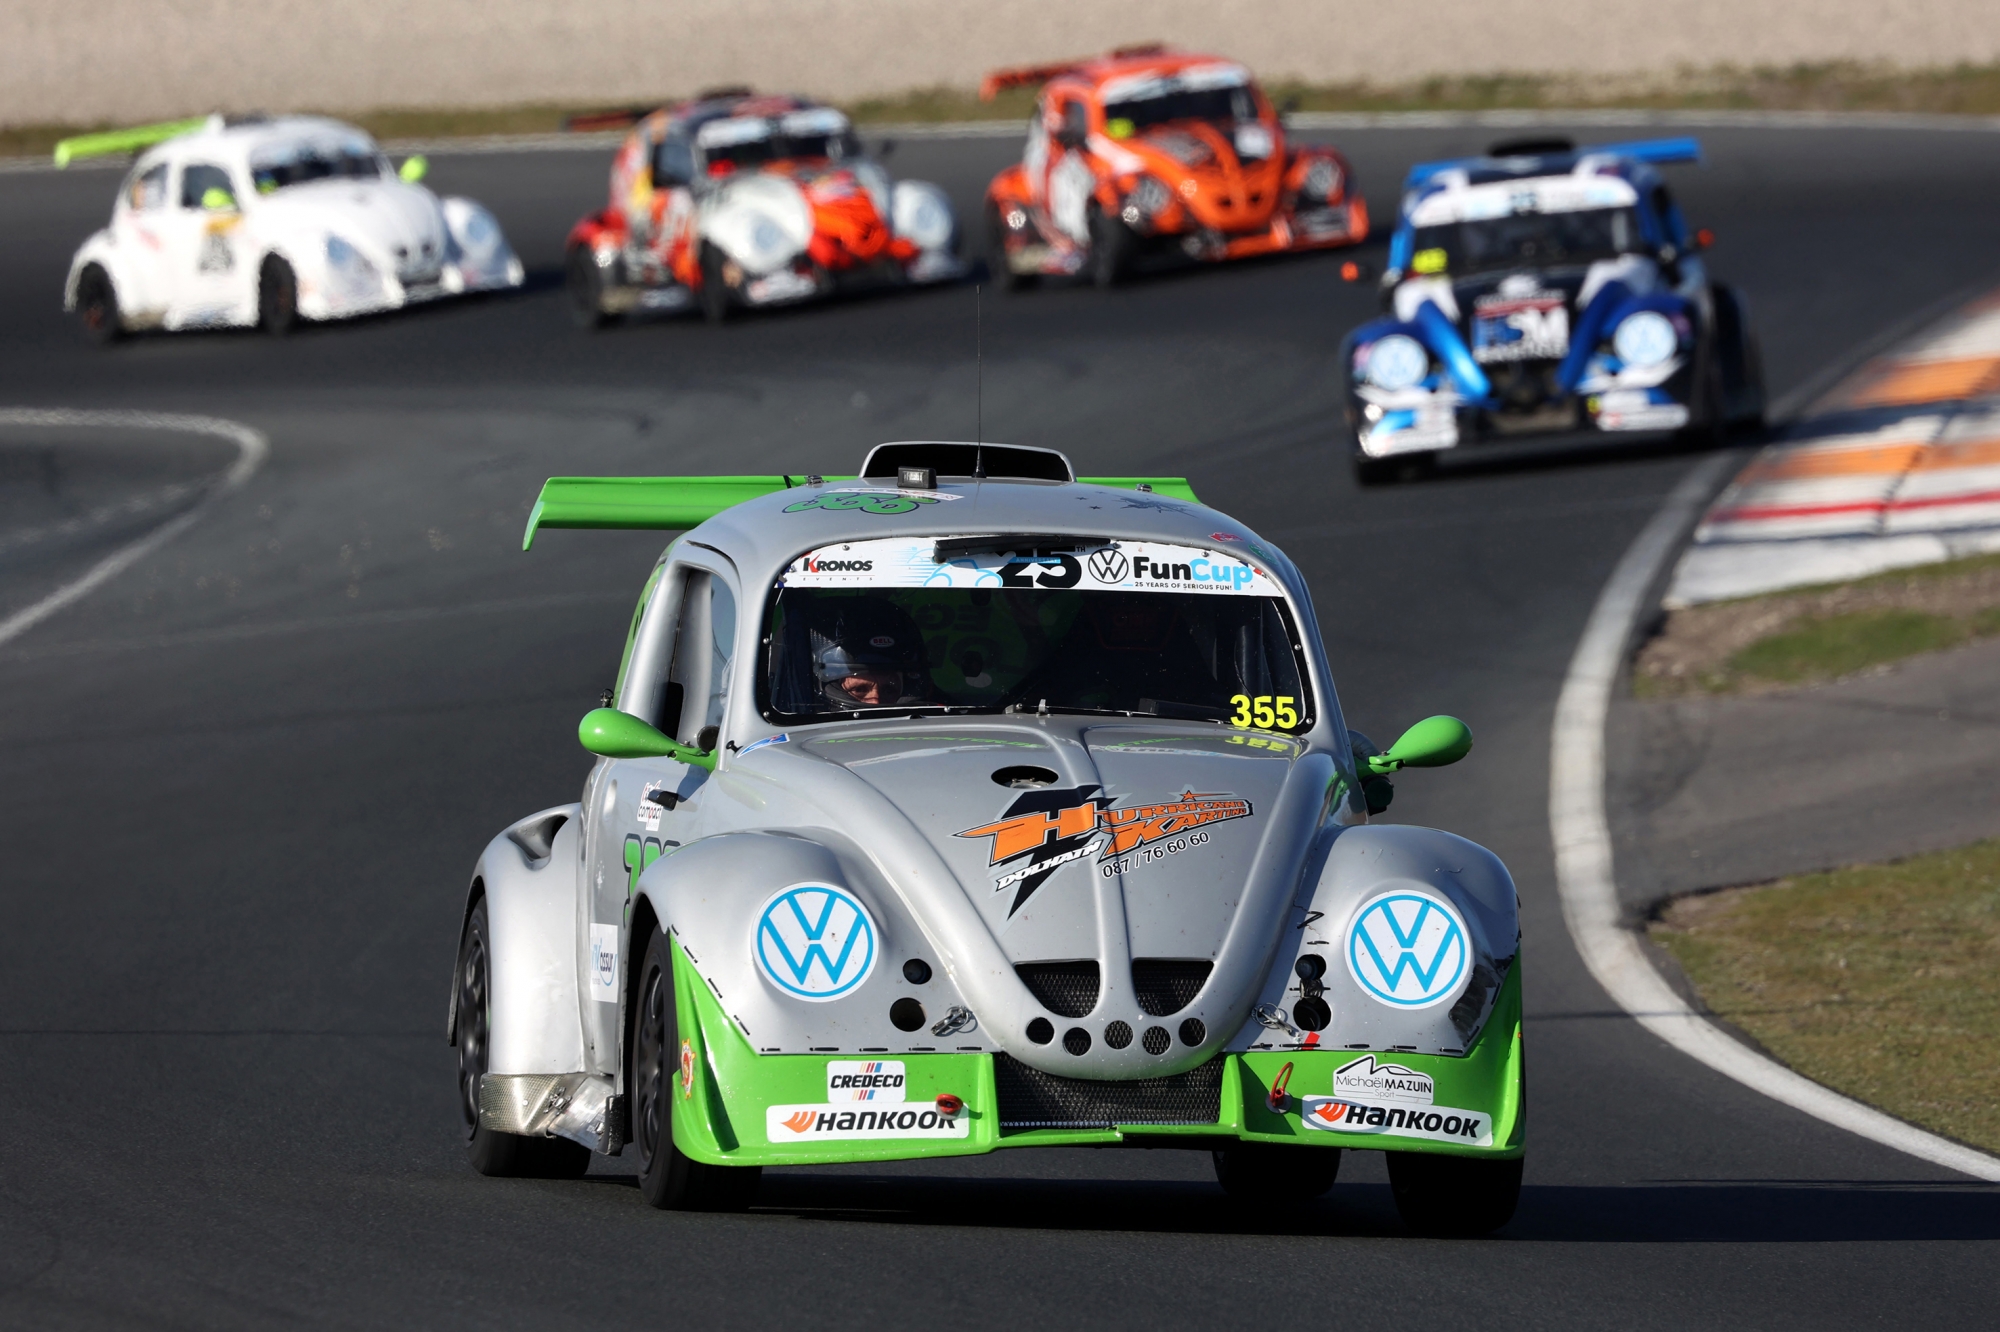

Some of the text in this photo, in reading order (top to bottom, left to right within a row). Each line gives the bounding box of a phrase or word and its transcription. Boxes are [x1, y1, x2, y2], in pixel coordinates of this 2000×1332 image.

[802, 554, 873, 573] KRONOS
[1133, 556, 1253, 590] FunCup
[1229, 694, 1298, 729] 355
[1102, 858, 1131, 877] 087
[1143, 846, 1164, 863] 76
[1166, 838, 1186, 854] 60
[1189, 832, 1209, 847] 60
[830, 1074, 904, 1089] CREDECO
[1375, 1089, 1395, 1099] Sport
